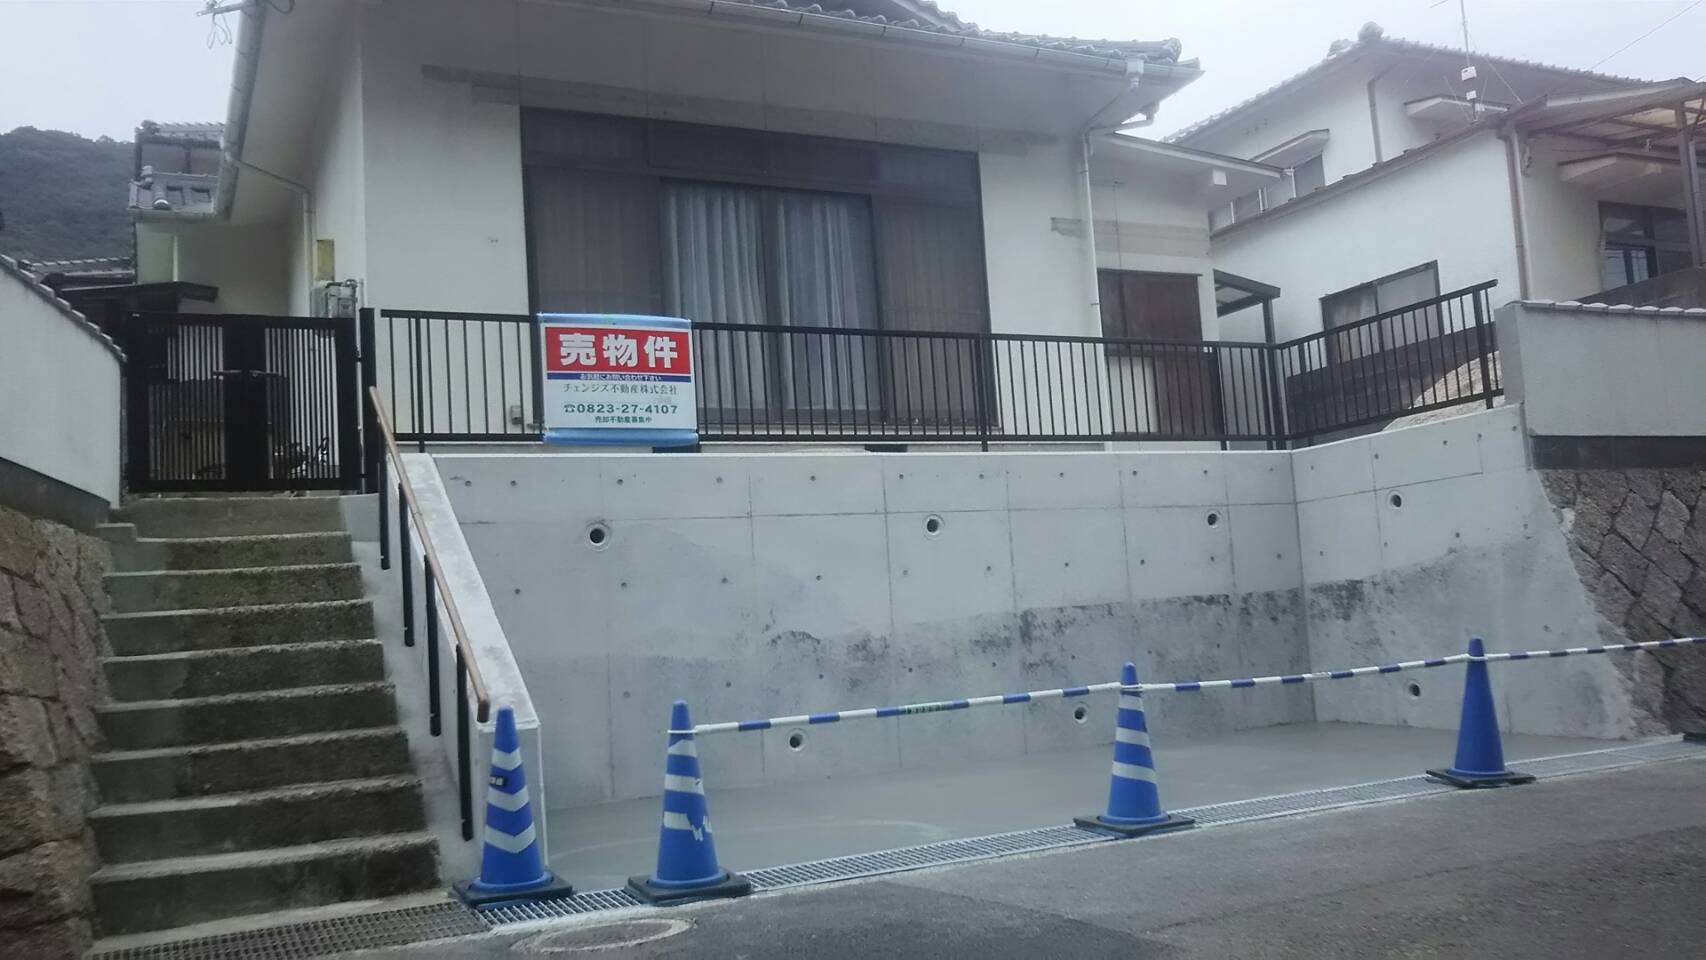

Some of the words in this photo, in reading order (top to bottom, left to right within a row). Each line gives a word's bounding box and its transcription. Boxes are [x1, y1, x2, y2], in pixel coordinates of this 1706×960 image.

[559, 333, 678, 368] 売物件
[563, 383, 678, 395] チェンジズ不動産株式会社
[577, 404, 678, 414] 0823-27-4107
